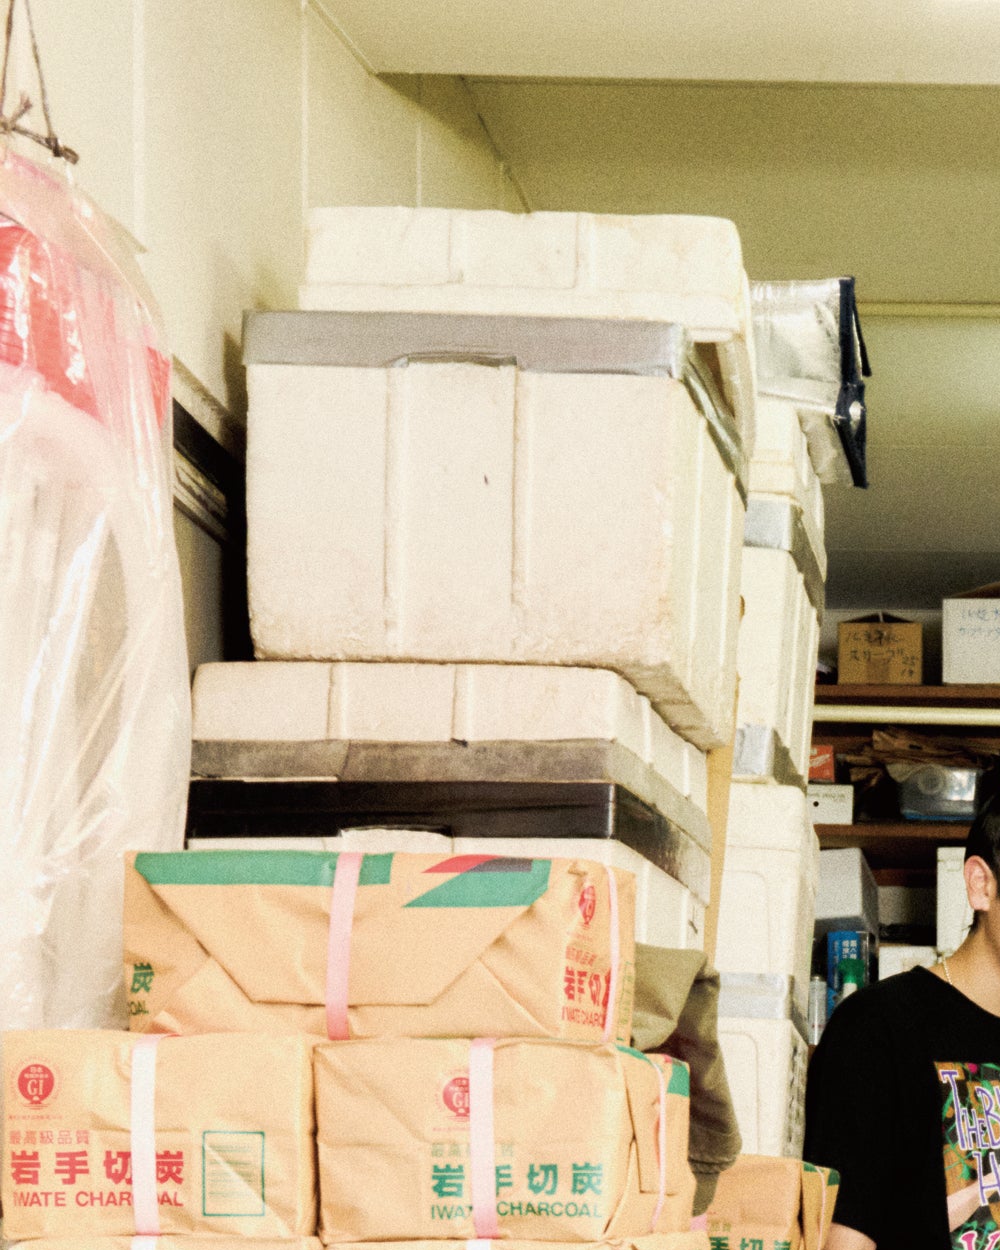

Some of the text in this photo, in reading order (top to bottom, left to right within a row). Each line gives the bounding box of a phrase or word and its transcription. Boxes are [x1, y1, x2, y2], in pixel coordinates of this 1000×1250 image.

[27, 1079, 44, 1096] GI
[75, 1191, 184, 1207] CHARAL
[496, 1201, 603, 1218] CHARCOAL
